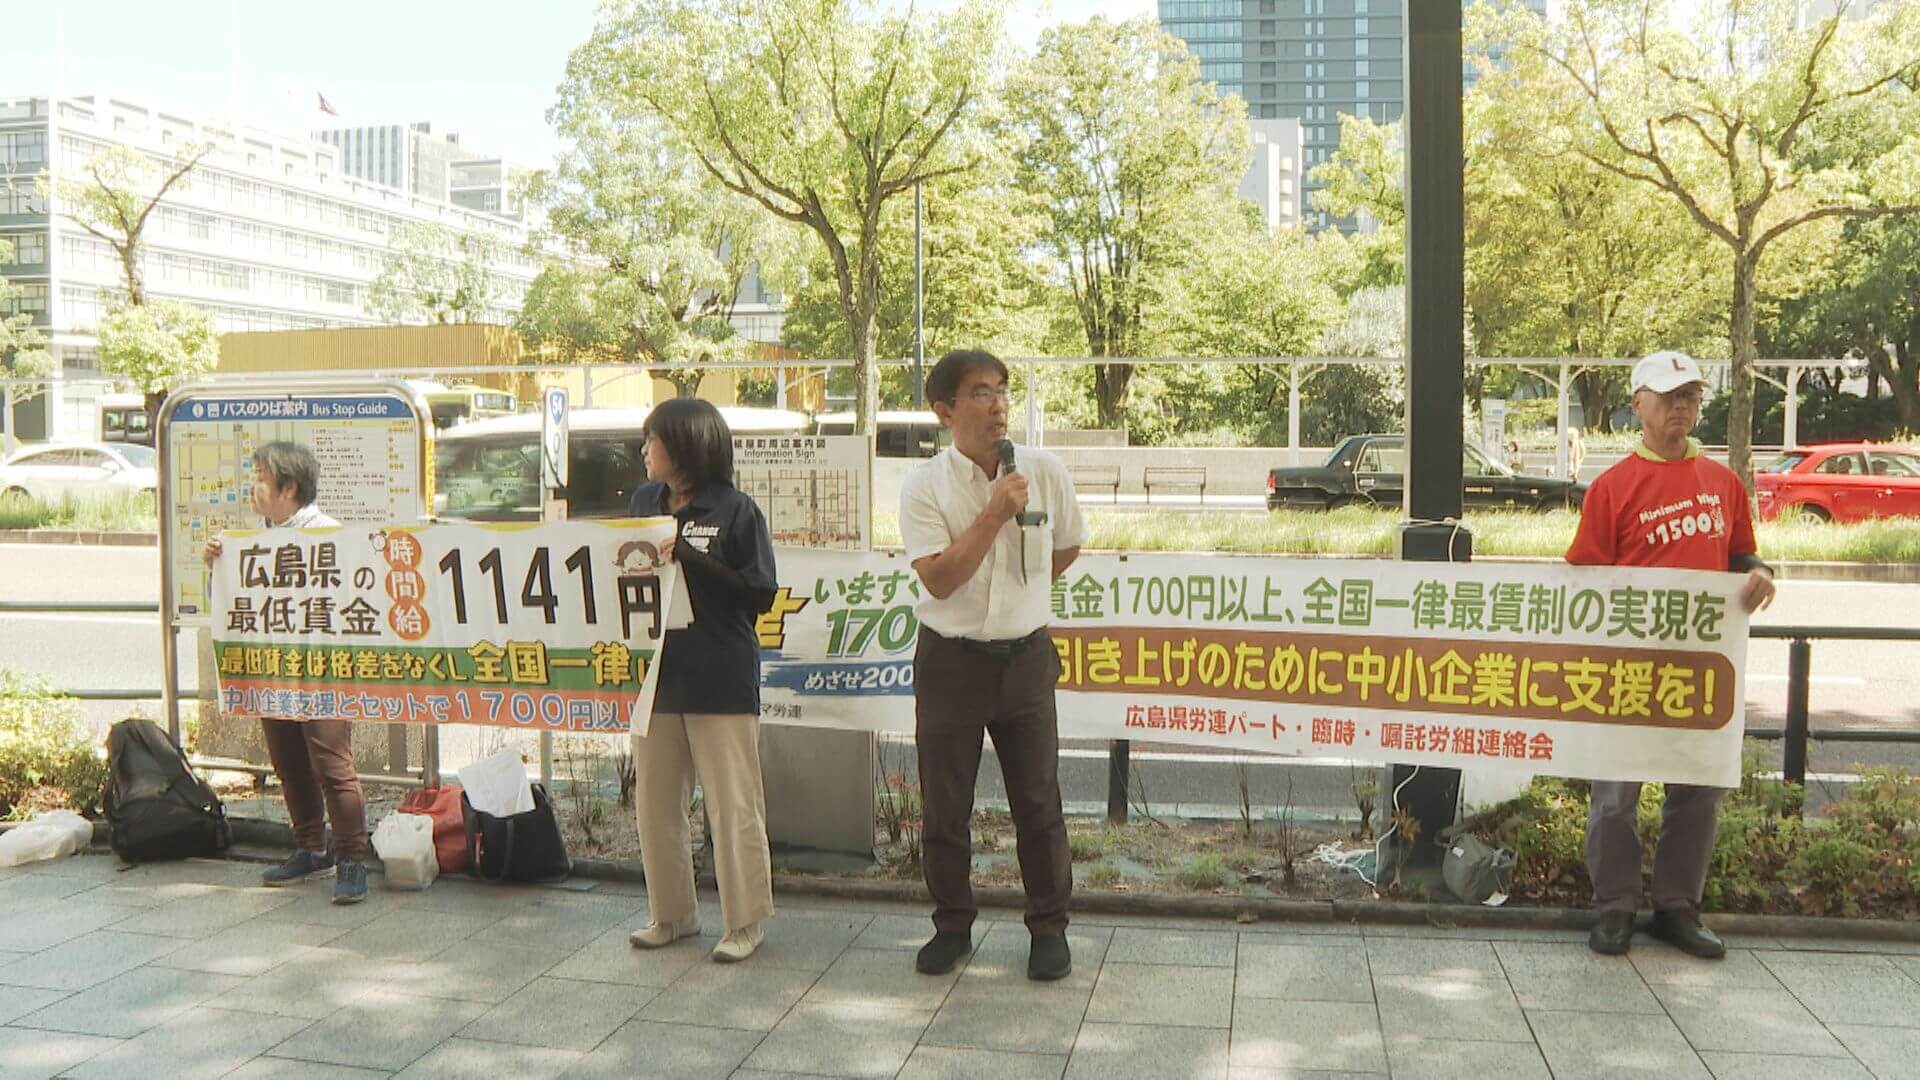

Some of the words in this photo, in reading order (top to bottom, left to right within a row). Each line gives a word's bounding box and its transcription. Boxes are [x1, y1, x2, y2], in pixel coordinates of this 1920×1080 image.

[223, 401, 307, 417] バスのりば案内
[312, 402, 330, 416] Bus
[332, 402, 355, 418] Stop
[357, 400, 388, 415] Guide
[551, 394, 564, 415] 54
[744, 449, 793, 458] Information
[795, 449, 815, 460] Sign
[1639, 499, 1694, 525] Minimum
[239, 541, 376, 590] 広島県の
[389, 537, 424, 635] 時間給
[438, 544, 662, 641] 1141円
[227, 596, 382, 636] 最低賃金
